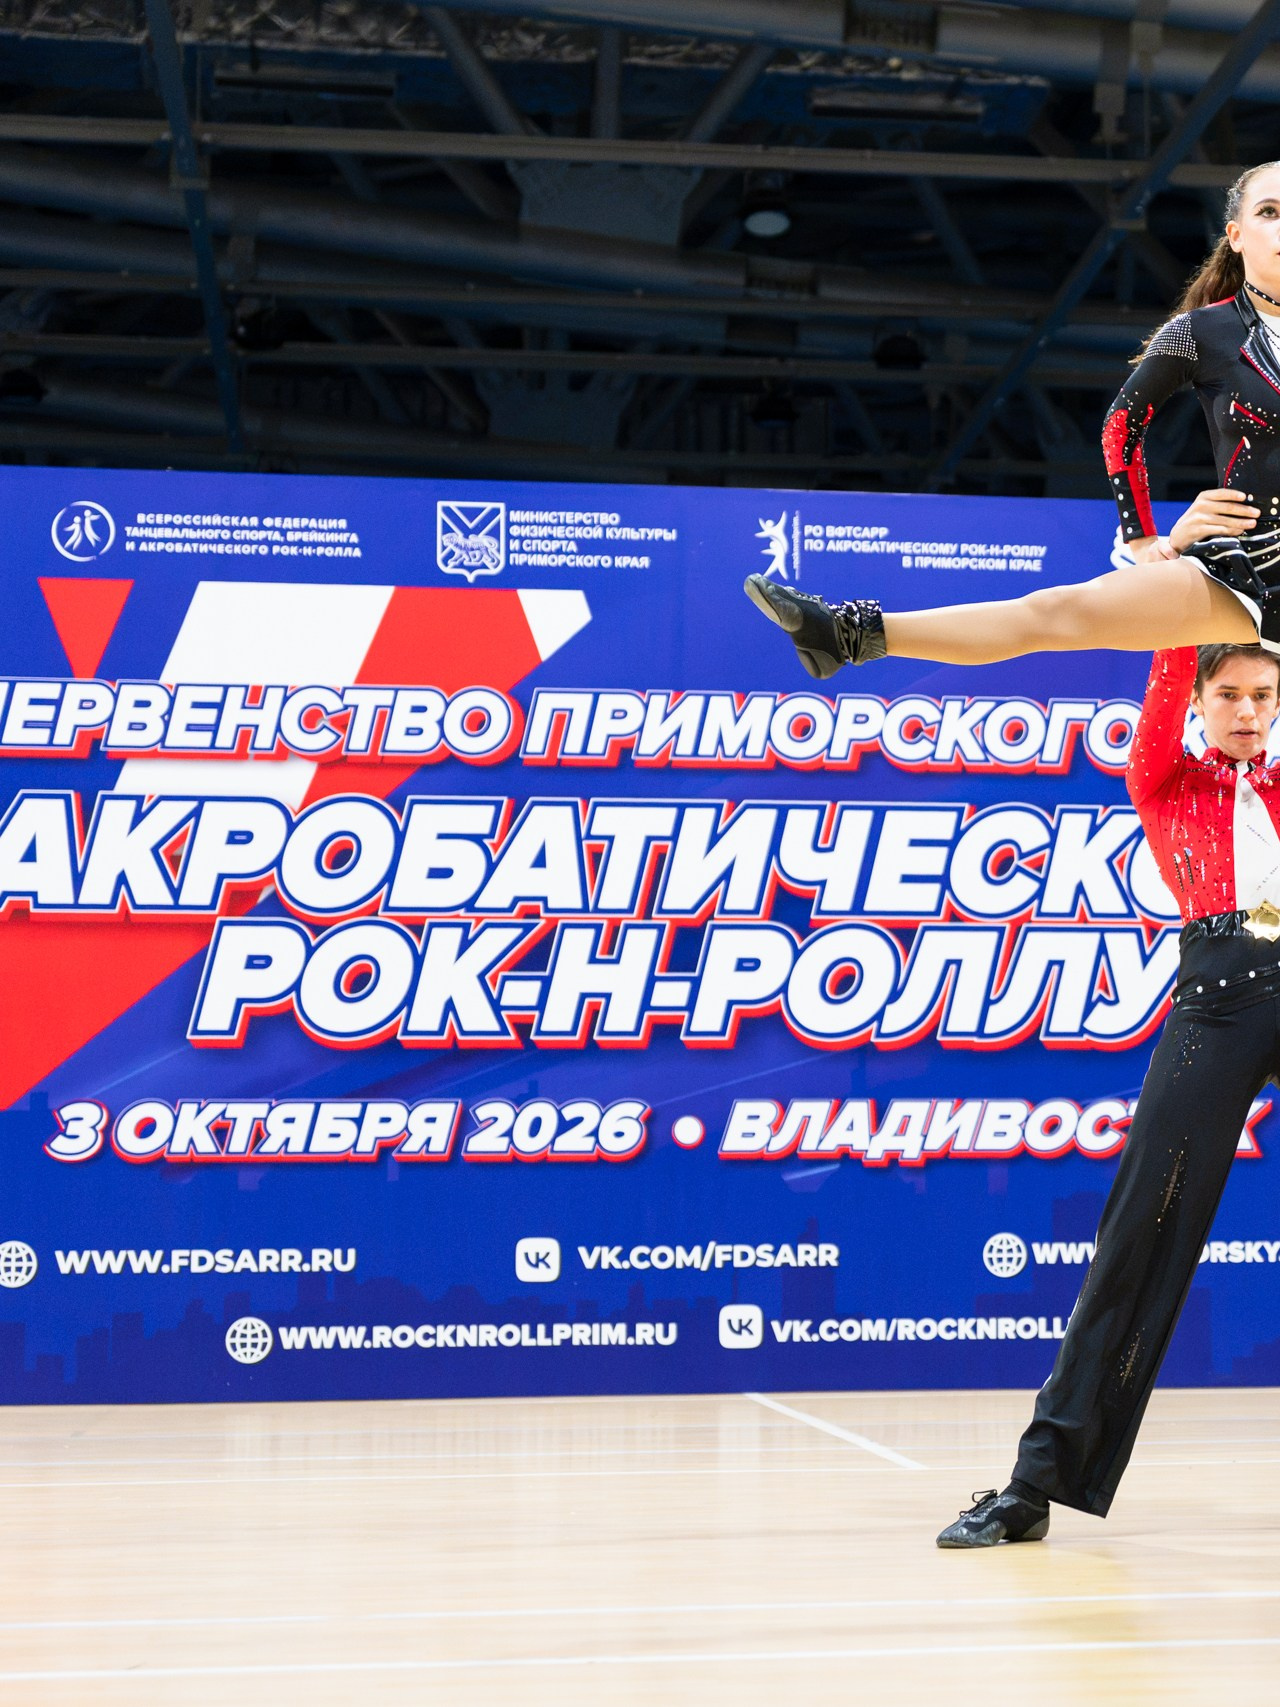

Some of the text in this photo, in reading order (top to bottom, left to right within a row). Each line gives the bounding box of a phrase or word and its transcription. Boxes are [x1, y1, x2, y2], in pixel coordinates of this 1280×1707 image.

[137, 513, 348, 530] ВСЕРОССИЙСКАЯ ФЕДЕРАЦИЯ
[509, 510, 620, 525] МИНИСТЕРСТВО
[125, 527, 359, 544] ТАНЦЕВАЛЬНОГО СПОРТА, БРЕЙКИНГА
[509, 524, 677, 541] ФИЗИЧЕСКОЙ КУЛЬТУРЫ
[804, 525, 889, 539] РО ВФТСАРР
[125, 541, 136, 551] И
[139, 541, 269, 555] АКРОБАТИЧЕСКОГО
[509, 540, 578, 552] И СПОРТА
[804, 540, 1047, 558] ПО АКРОБАТИЧЕСКОМУ РОК-Н-РОЛЛУ
[509, 553, 650, 568] ПРИМОРСКОГО КРАЯ
[902, 556, 1042, 572] В ПРИМОРСКОМ КРАЕ
[0, 680, 514, 757] ЕРВЕНСТВО
[190, 918, 1180, 1046] РОК-Н-РОЛЛУ
[48, 1099, 106, 1160] 3
[114, 1099, 457, 1159] ОКТЯБРЯ
[464, 1099, 647, 1158] 2026
[54, 1247, 357, 1276] WWW.FDSARR.RU
[577, 1241, 840, 1273] VK.COM/FDSARR
[279, 1321, 679, 1351] WWW.ROCKNROLLPRIM.RU
